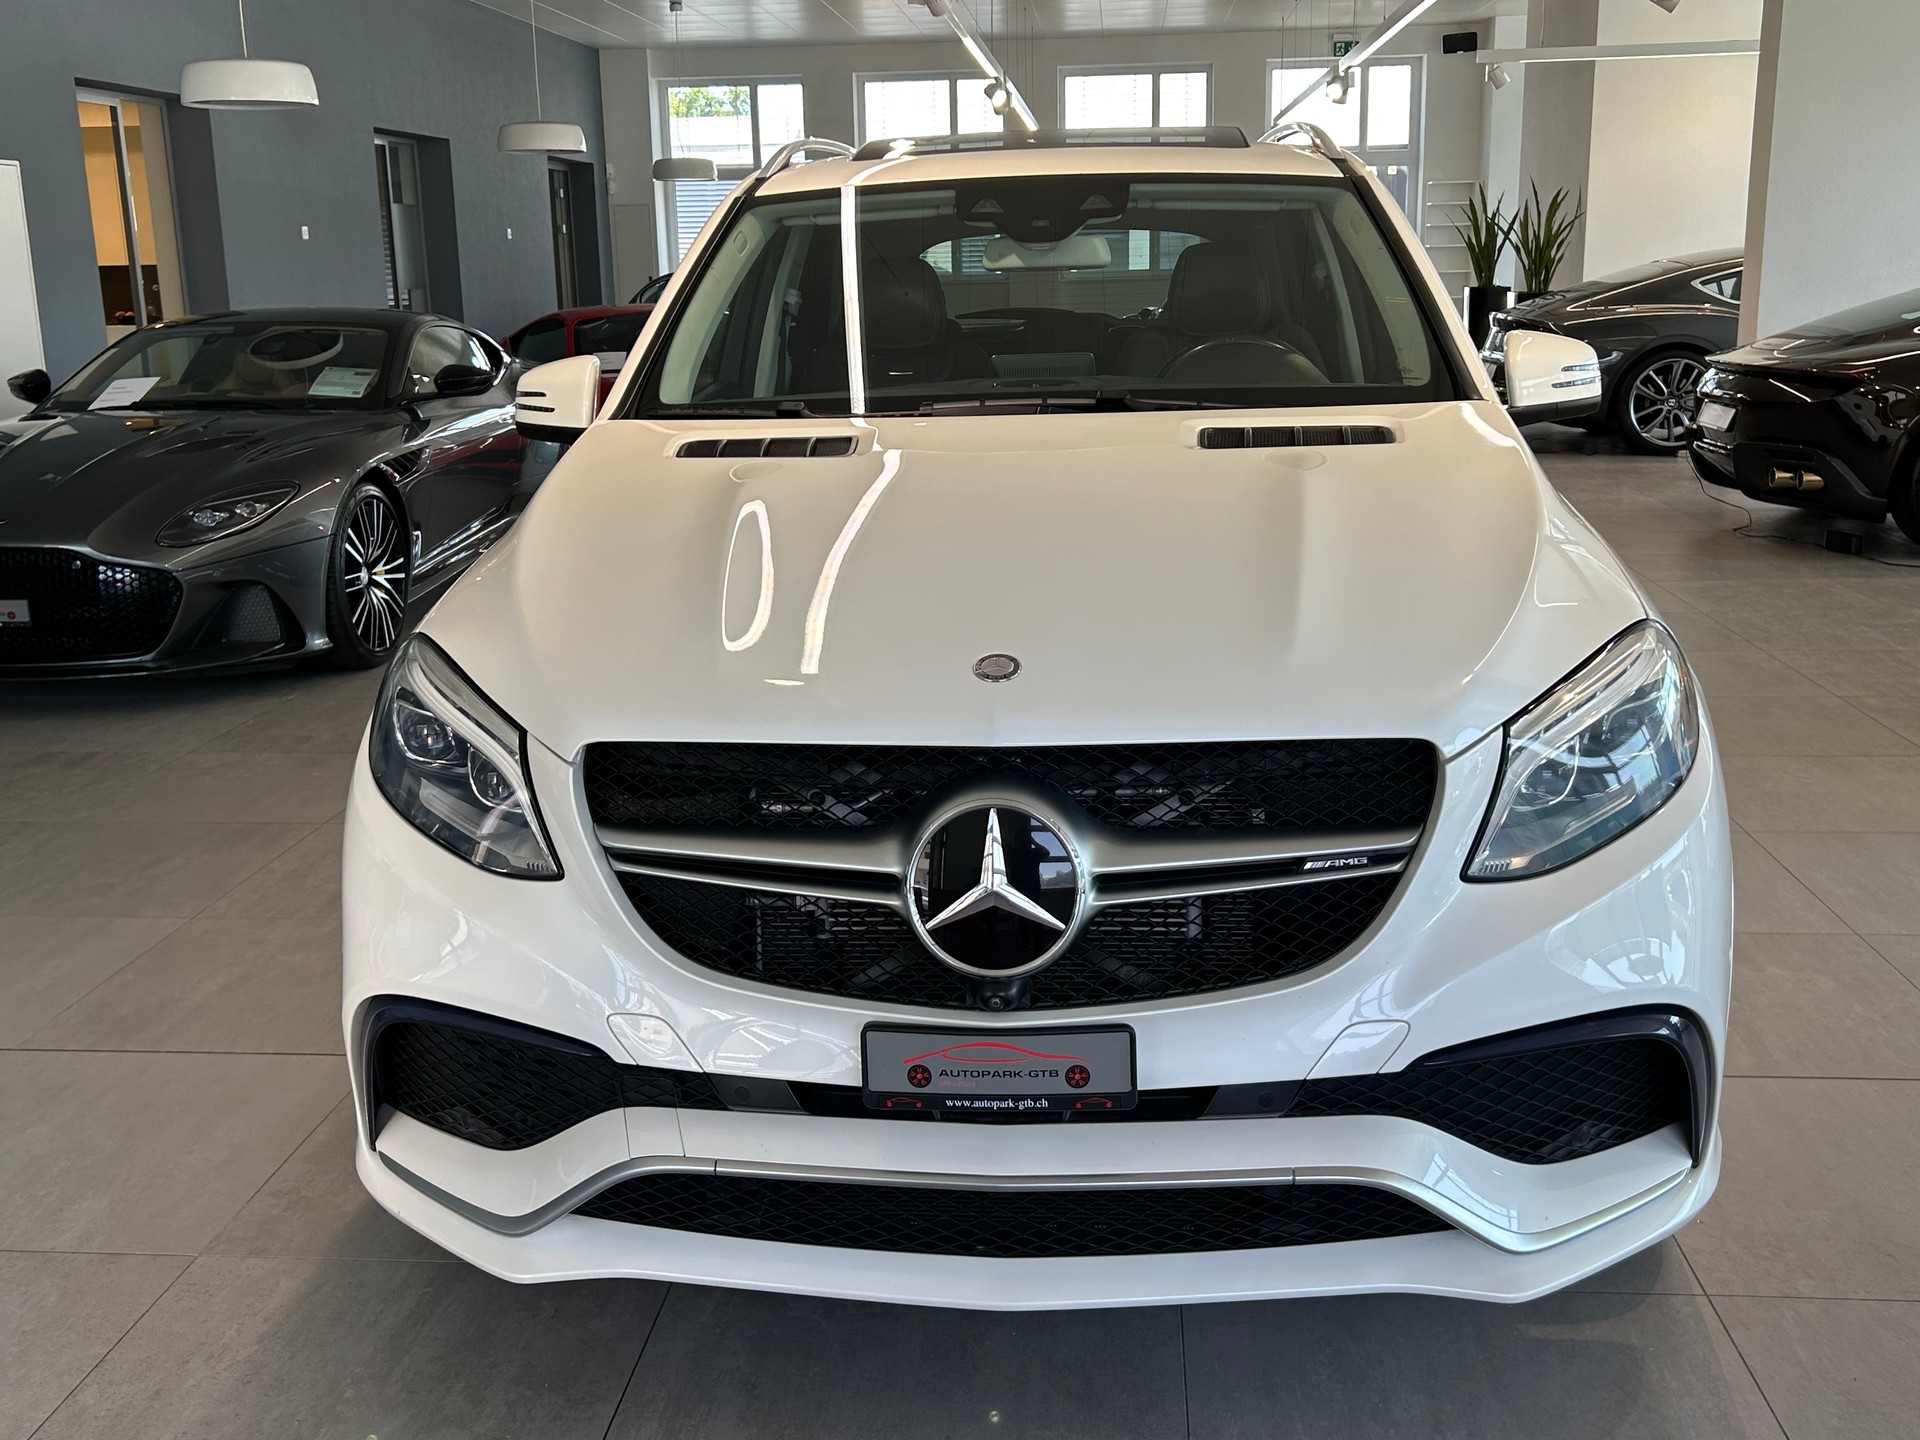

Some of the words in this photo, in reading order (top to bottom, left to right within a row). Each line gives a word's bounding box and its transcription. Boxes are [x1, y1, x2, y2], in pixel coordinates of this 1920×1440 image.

[1324, 856, 1368, 868] AMG
[939, 1069, 1059, 1078] AUTOPARK-GTB
[945, 1098, 1048, 1110] www.autopark-gtb.ch
